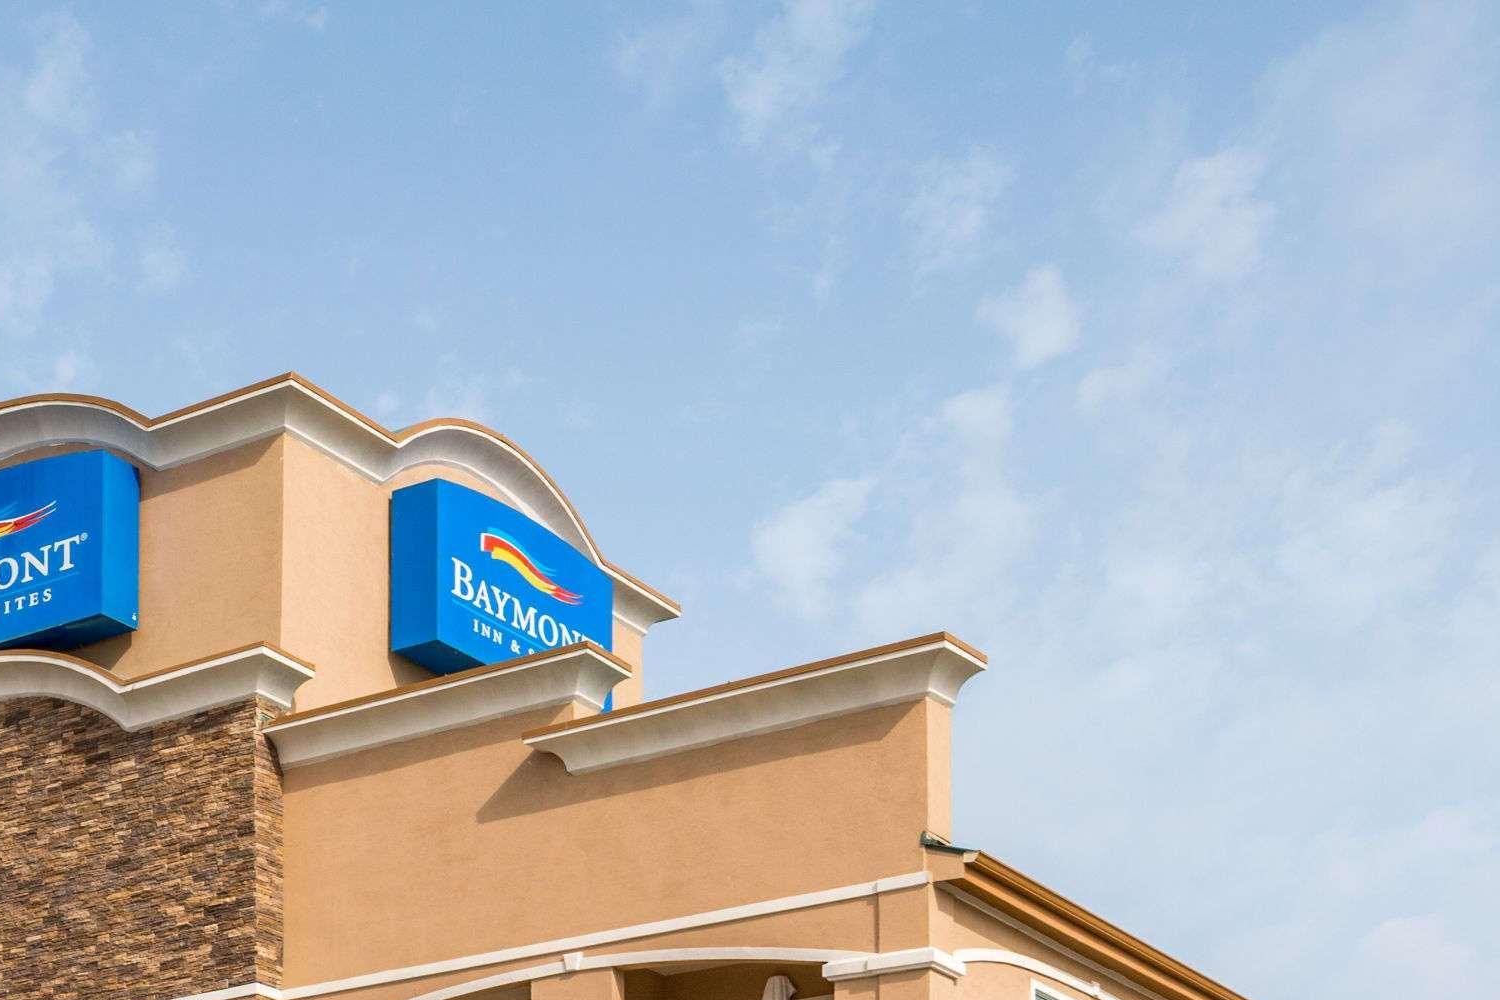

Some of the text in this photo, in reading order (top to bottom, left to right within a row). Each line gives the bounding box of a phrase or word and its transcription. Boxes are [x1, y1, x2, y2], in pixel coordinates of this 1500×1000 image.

[451, 556, 604, 648] BAYMON
[472, 619, 521, 655] INN &
